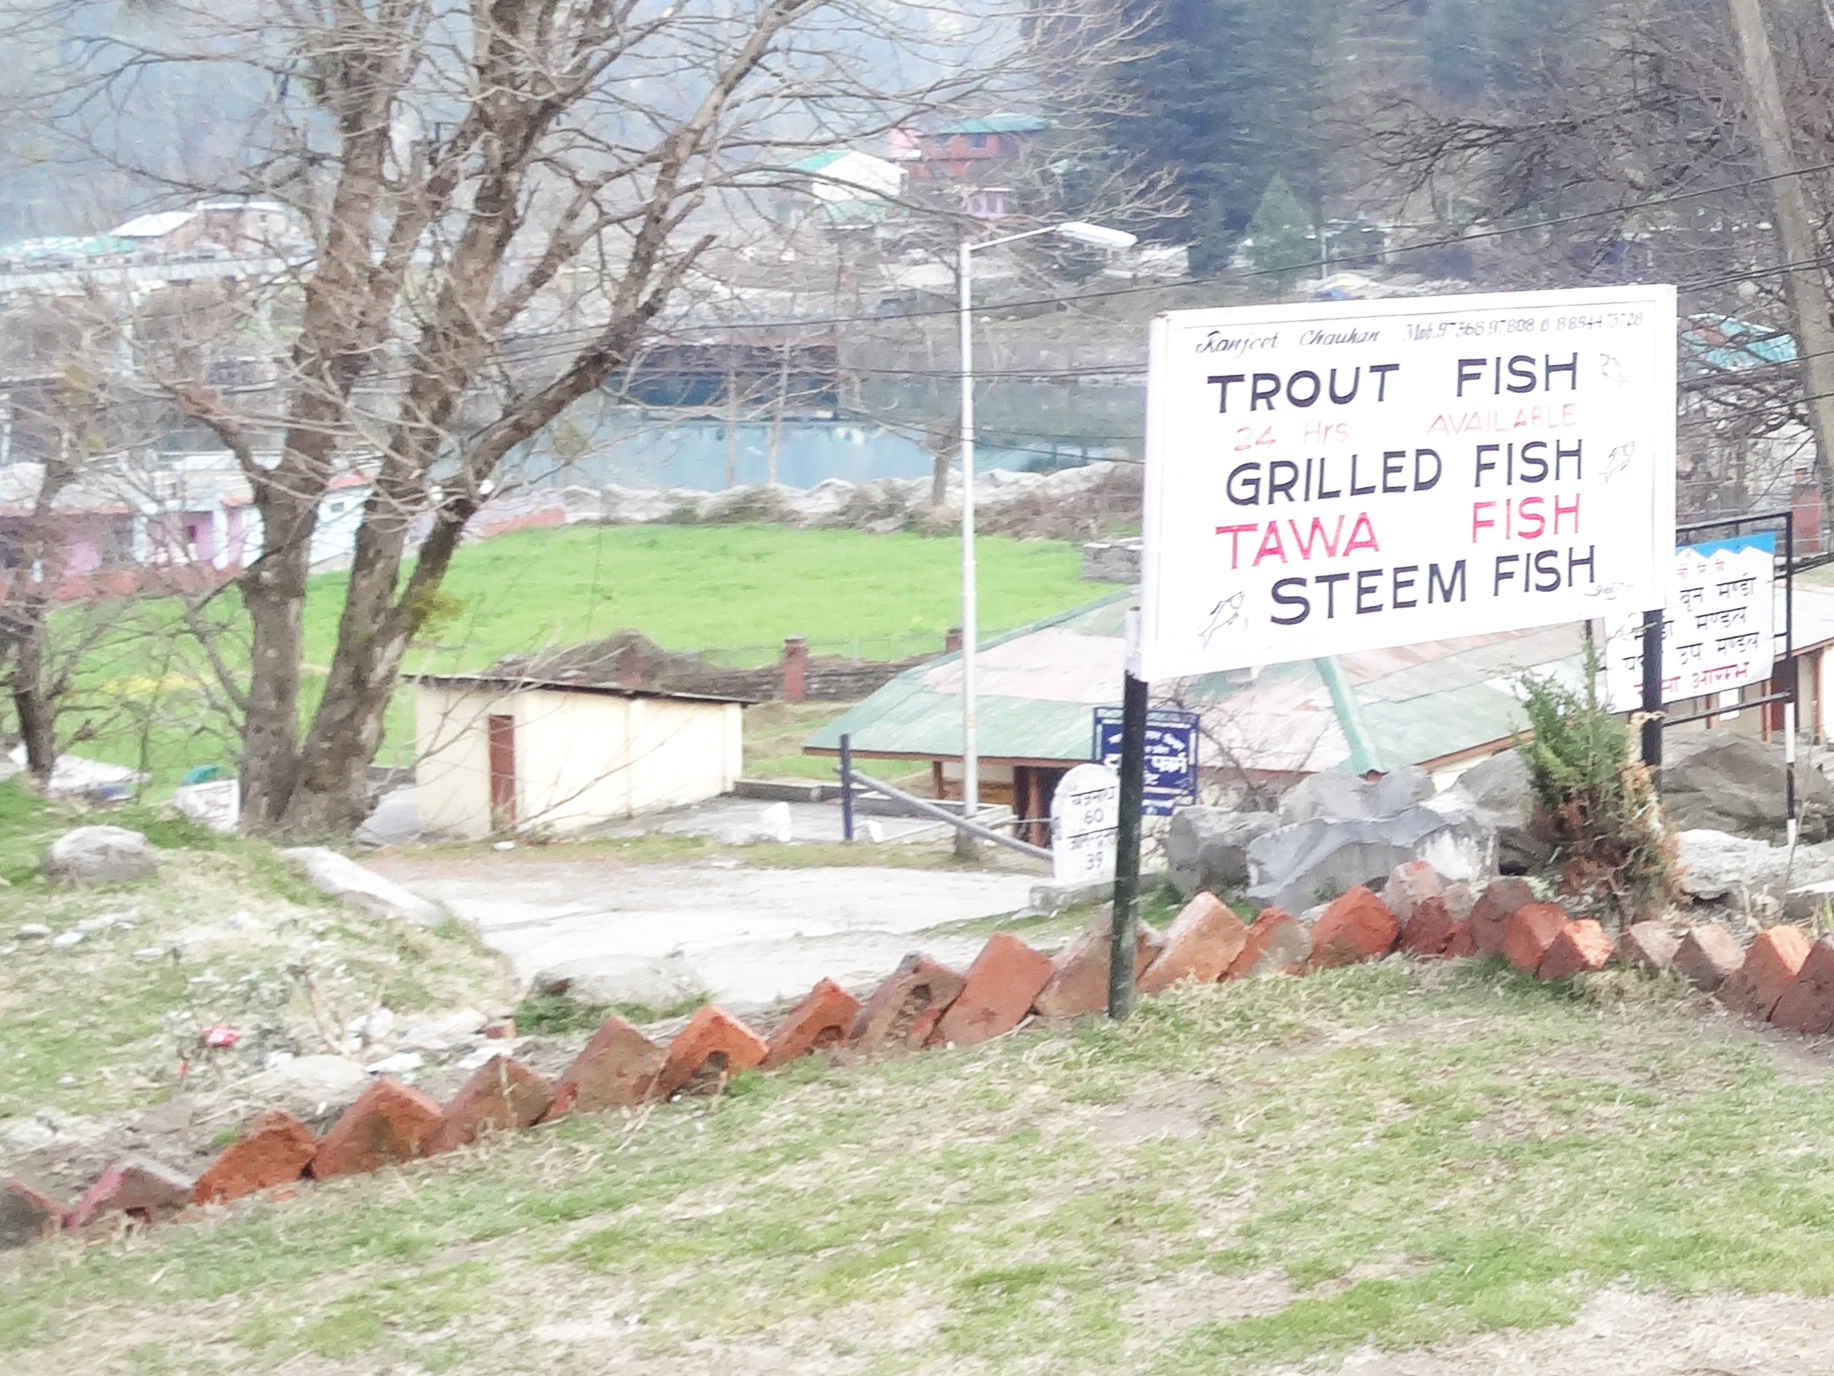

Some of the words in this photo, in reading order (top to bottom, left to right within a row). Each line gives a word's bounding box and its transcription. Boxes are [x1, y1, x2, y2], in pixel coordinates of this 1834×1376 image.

[1301, 328, 1381, 348] Chauhan
[1207, 363, 1399, 413] TROUT
[1456, 352, 1578, 398] FISH
[1232, 424, 1277, 452] 24
[1425, 402, 1578, 437] AVAILABLE
[1225, 448, 1443, 506] GRILLED
[1474, 439, 1583, 488] FISH
[1215, 512, 1380, 570] TAWA
[1471, 493, 1581, 543] FISH
[1269, 559, 1467, 627] STEEM
[1493, 545, 1597, 597] FISH
[1083, 807, 1105, 825] 60
